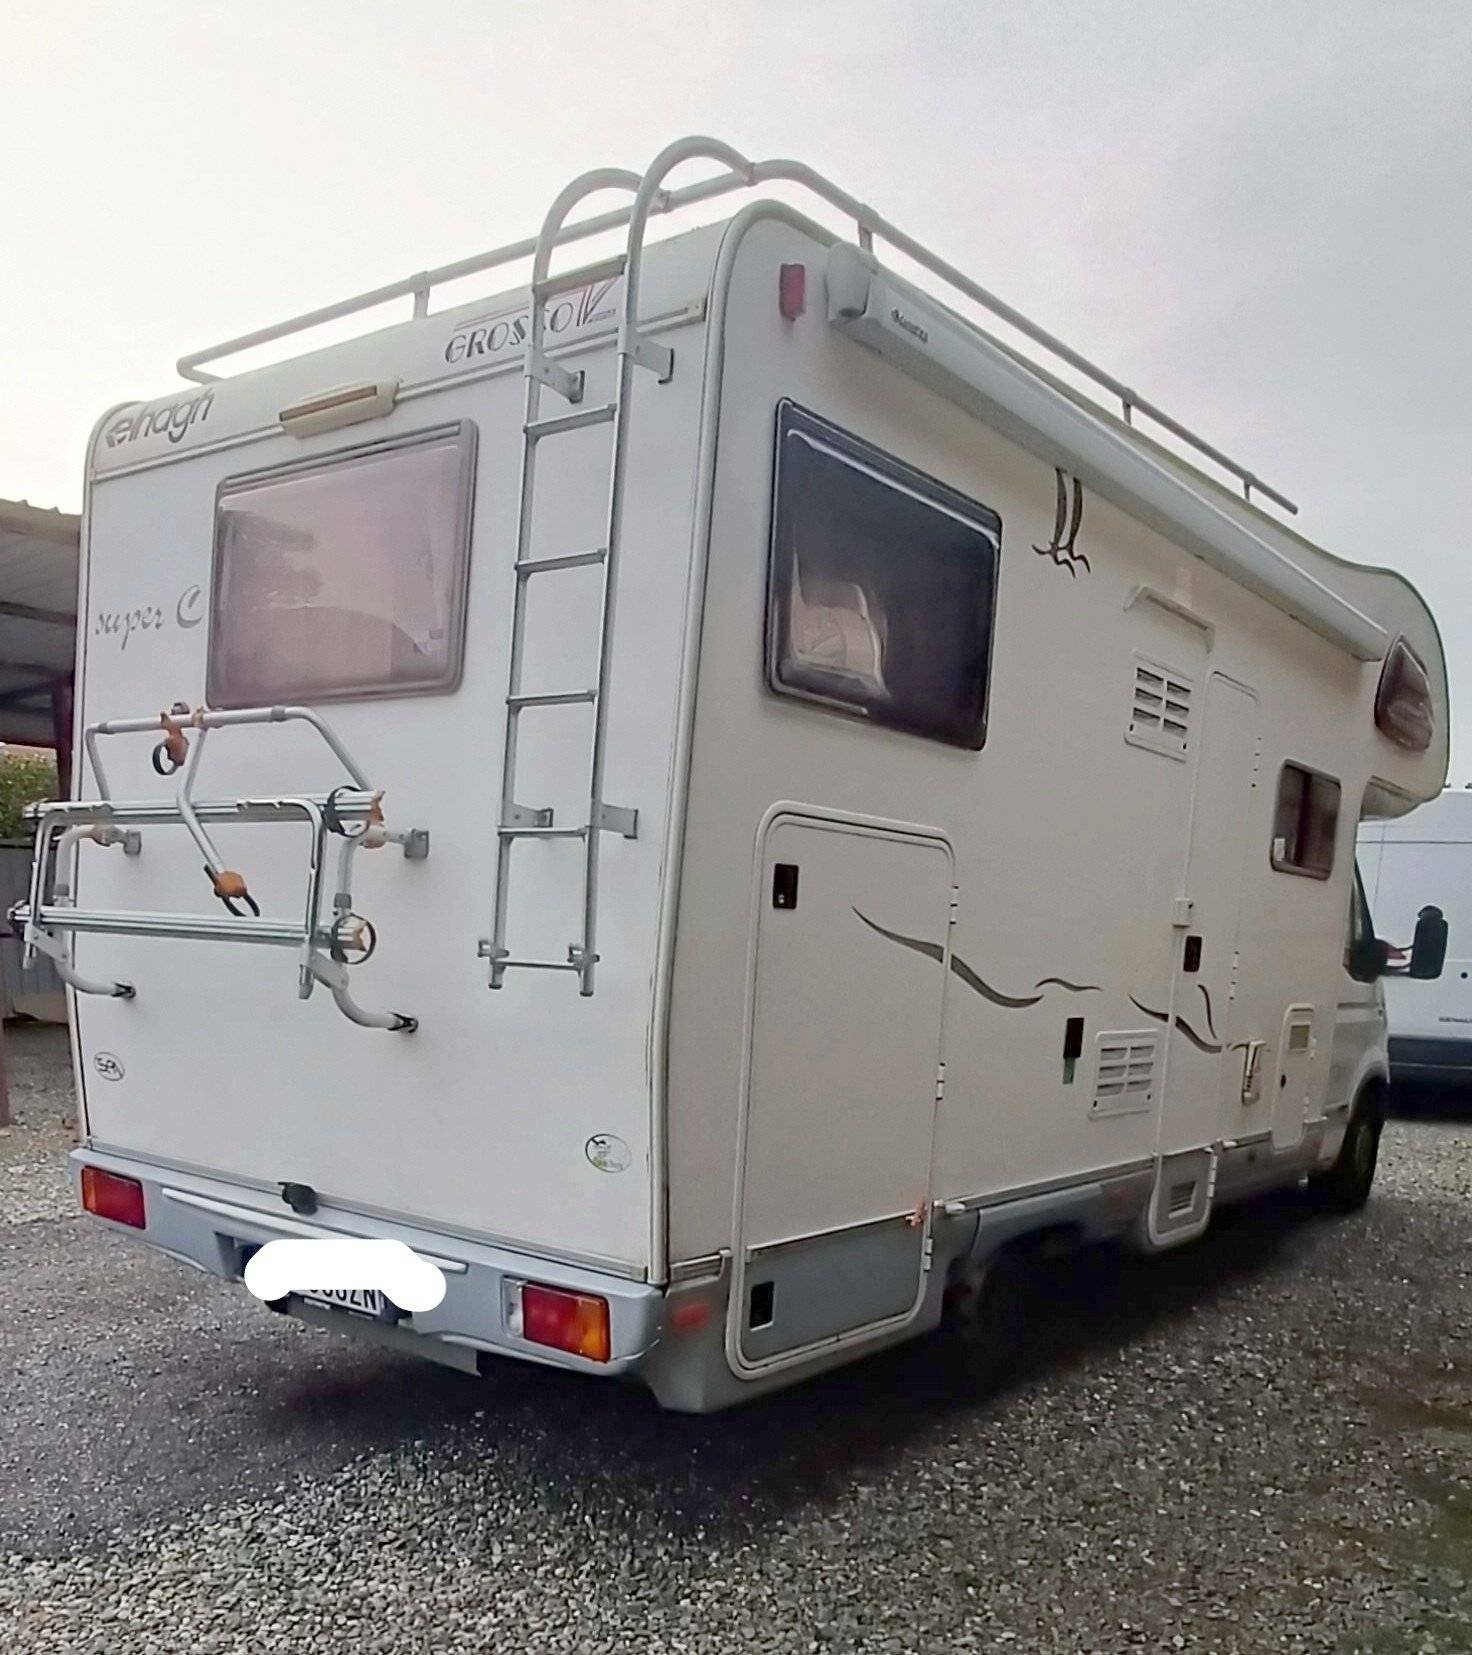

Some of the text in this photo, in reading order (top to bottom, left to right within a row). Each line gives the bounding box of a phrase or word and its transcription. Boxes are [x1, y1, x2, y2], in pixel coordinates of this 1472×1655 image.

[444, 300, 575, 364] GROSO
[95, 583, 203, 651] super C
